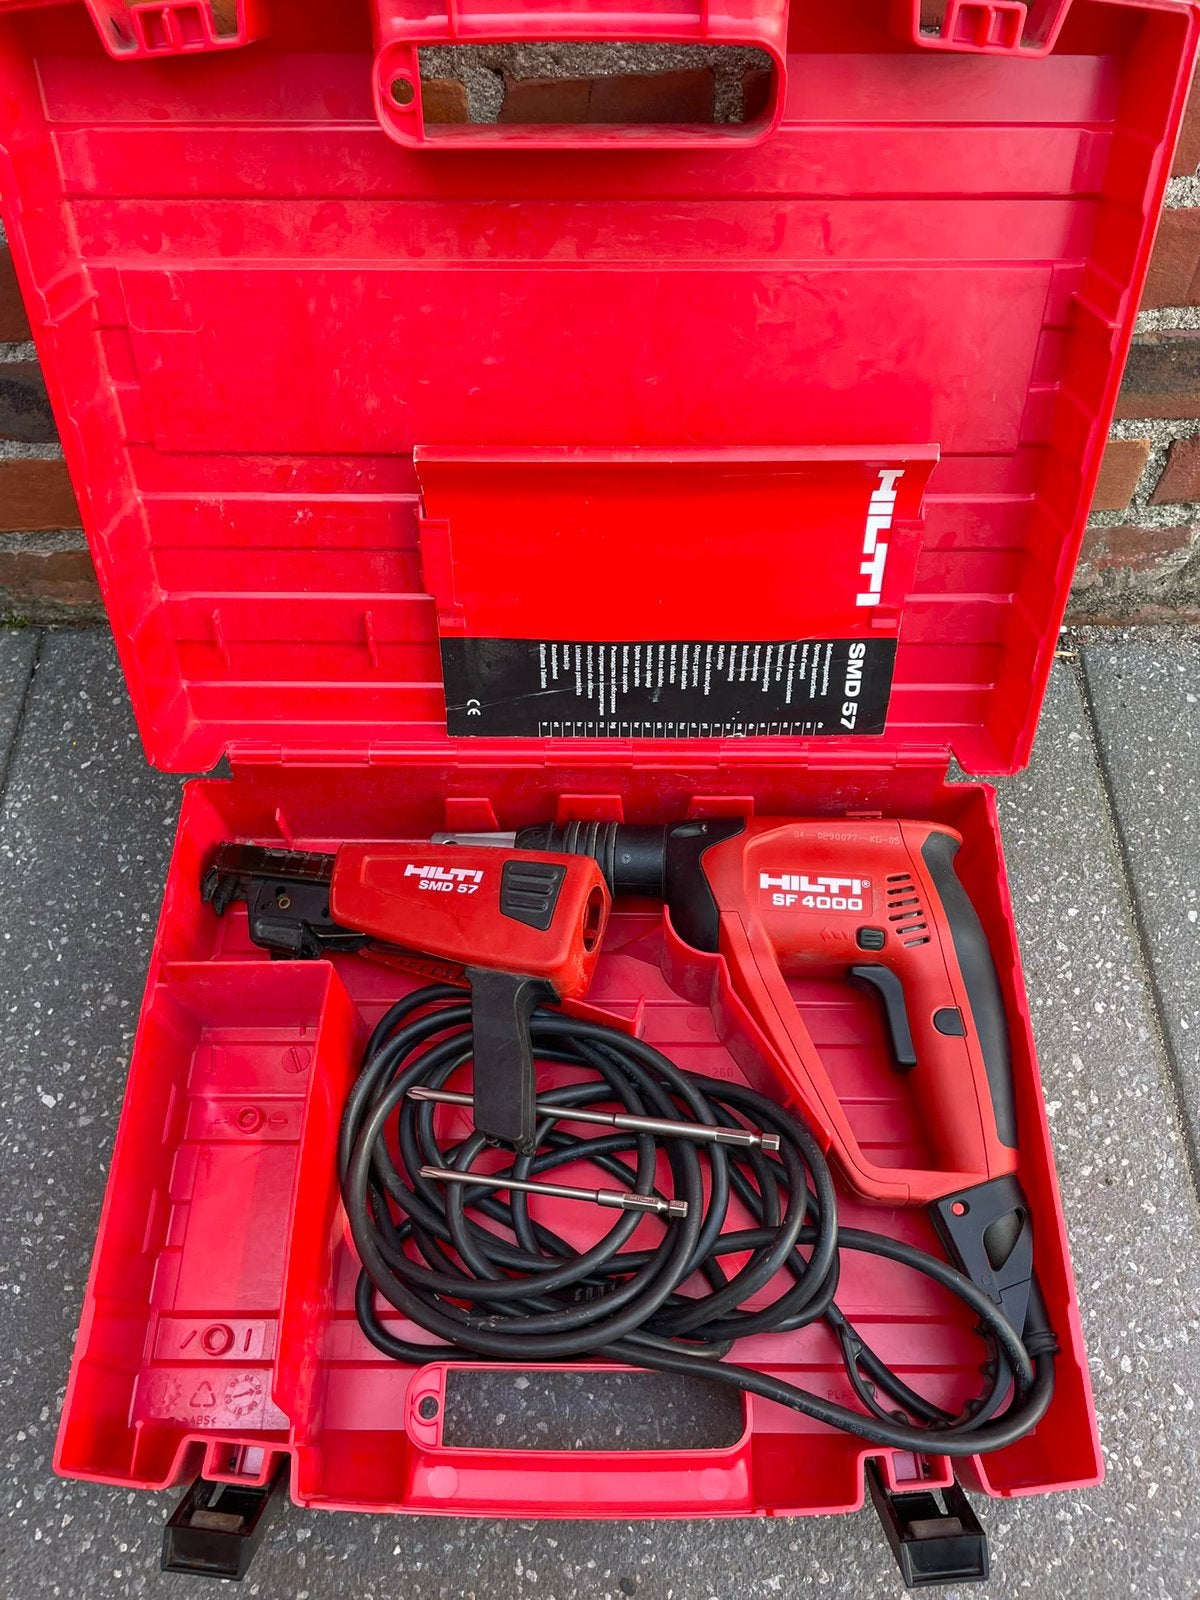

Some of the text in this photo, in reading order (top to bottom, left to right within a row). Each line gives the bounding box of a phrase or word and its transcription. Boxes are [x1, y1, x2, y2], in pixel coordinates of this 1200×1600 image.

[856, 469, 905, 606] HILTI
[811, 644, 821, 667] Operating
[821, 643, 833, 695] Bedienungsanleitung
[786, 670, 794, 703] instrucciones
[840, 642, 866, 730] SMD 57
[403, 863, 484, 884] HILTI
[418, 879, 480, 895] SMD 57
[772, 893, 863, 911] SF 4000
